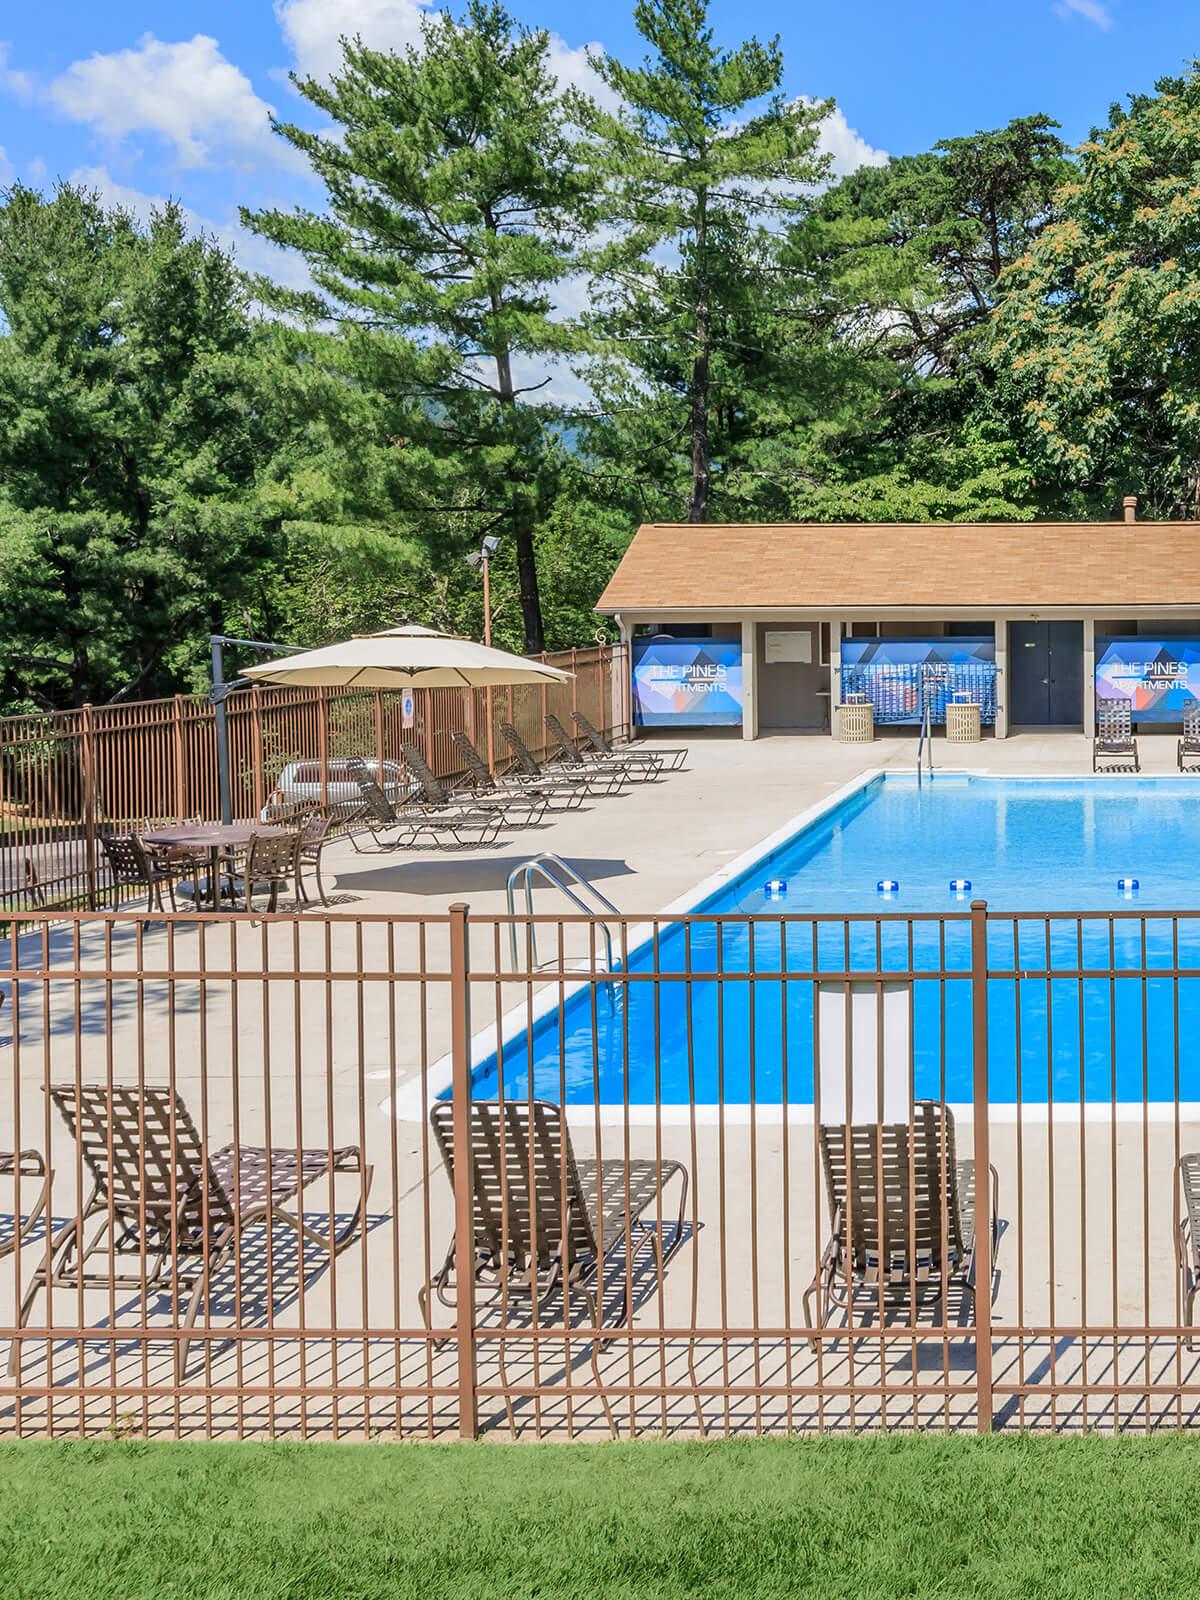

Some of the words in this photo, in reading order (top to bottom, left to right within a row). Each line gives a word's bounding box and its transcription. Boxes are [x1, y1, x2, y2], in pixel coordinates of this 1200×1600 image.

[682, 664, 727, 677] PINES
[1112, 662, 1141, 675] THE
[1144, 662, 1188, 675] PINES
[651, 683, 727, 692] ATMENTS
